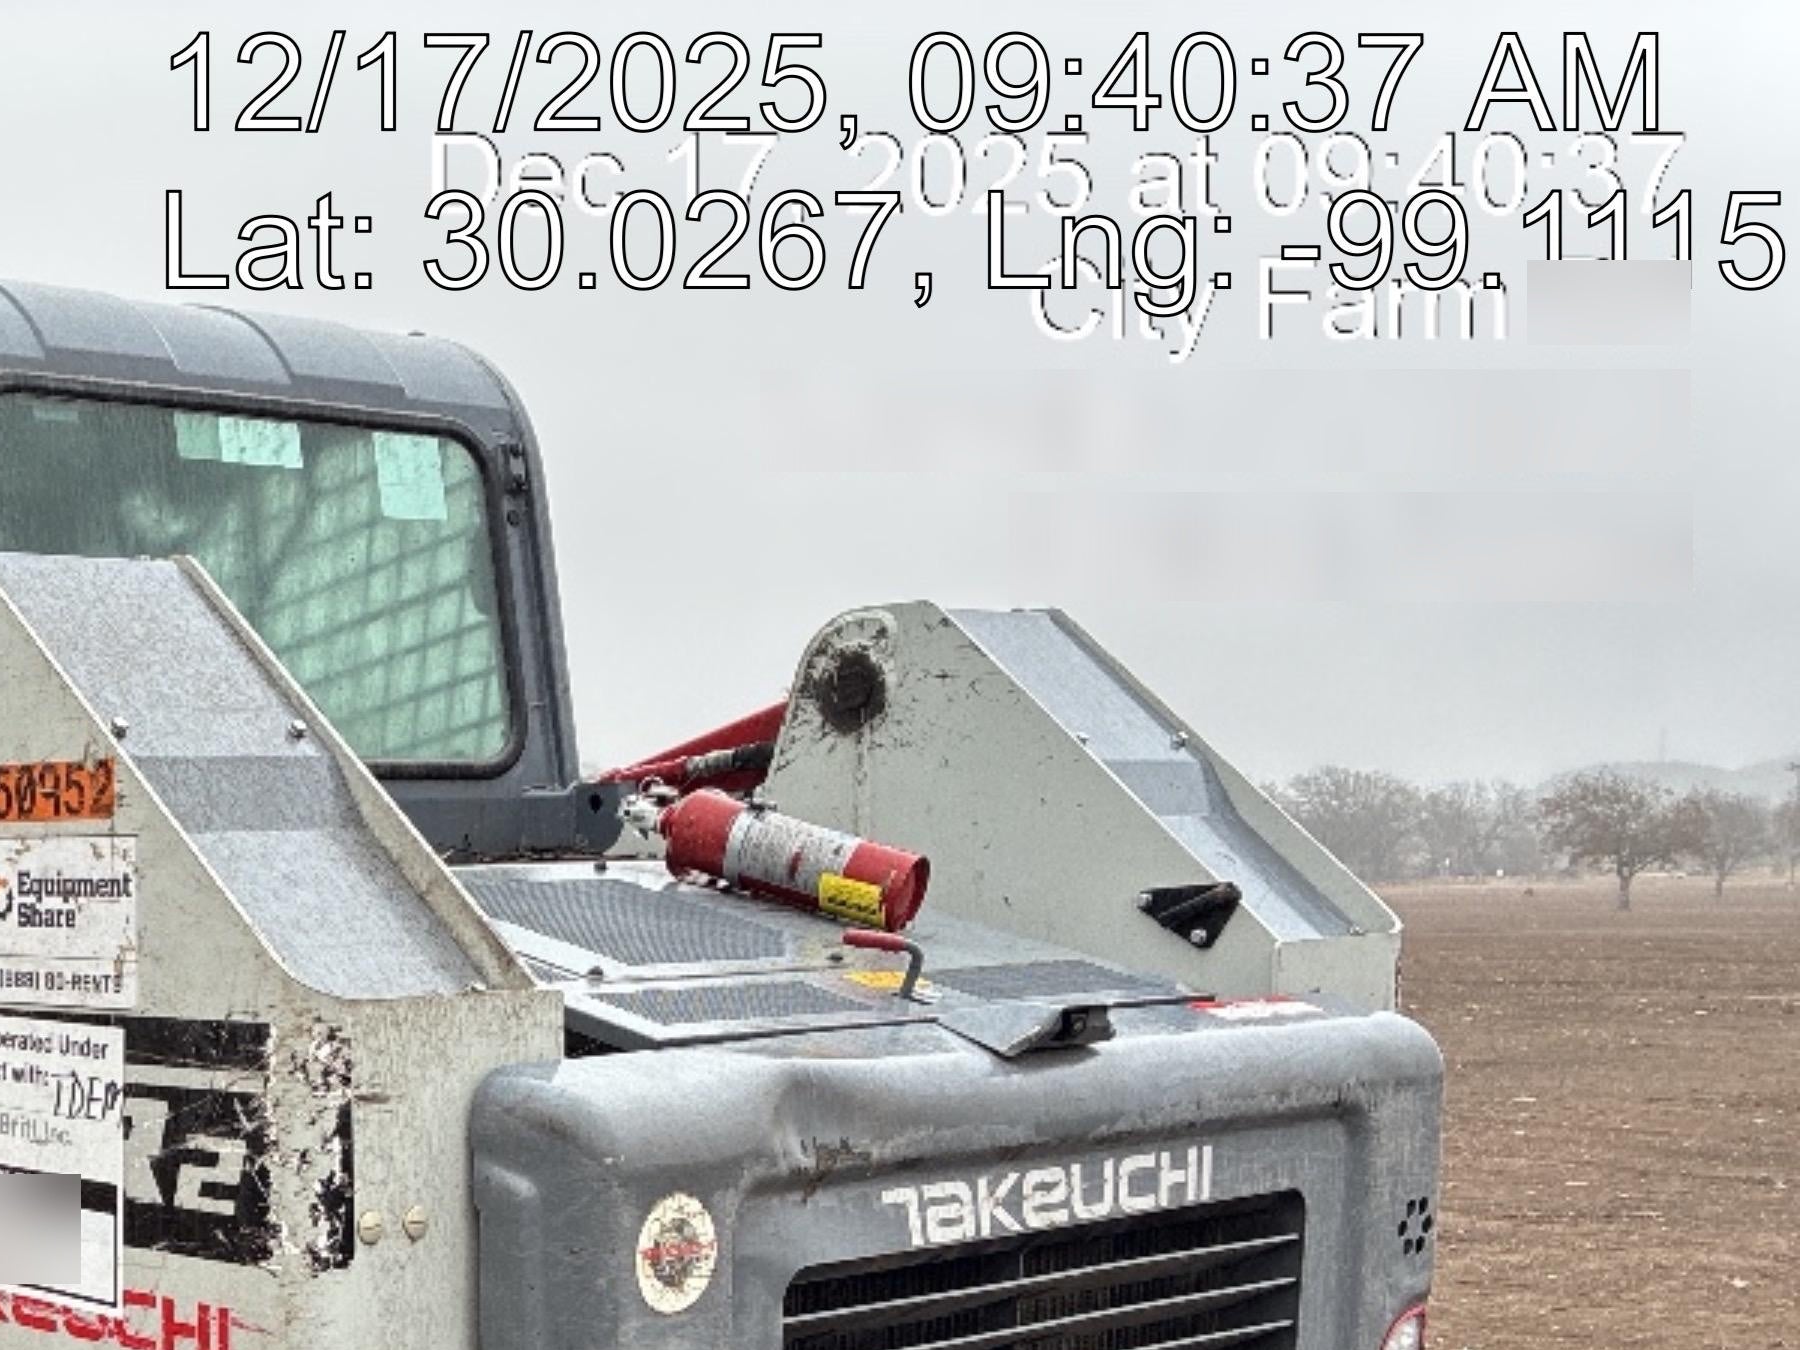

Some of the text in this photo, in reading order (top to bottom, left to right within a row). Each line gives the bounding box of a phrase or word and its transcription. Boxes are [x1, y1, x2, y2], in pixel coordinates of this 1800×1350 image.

[17, 870, 133, 903] Equipment
[17, 902, 77, 928] Share
[58, 1033, 110, 1060] Under
